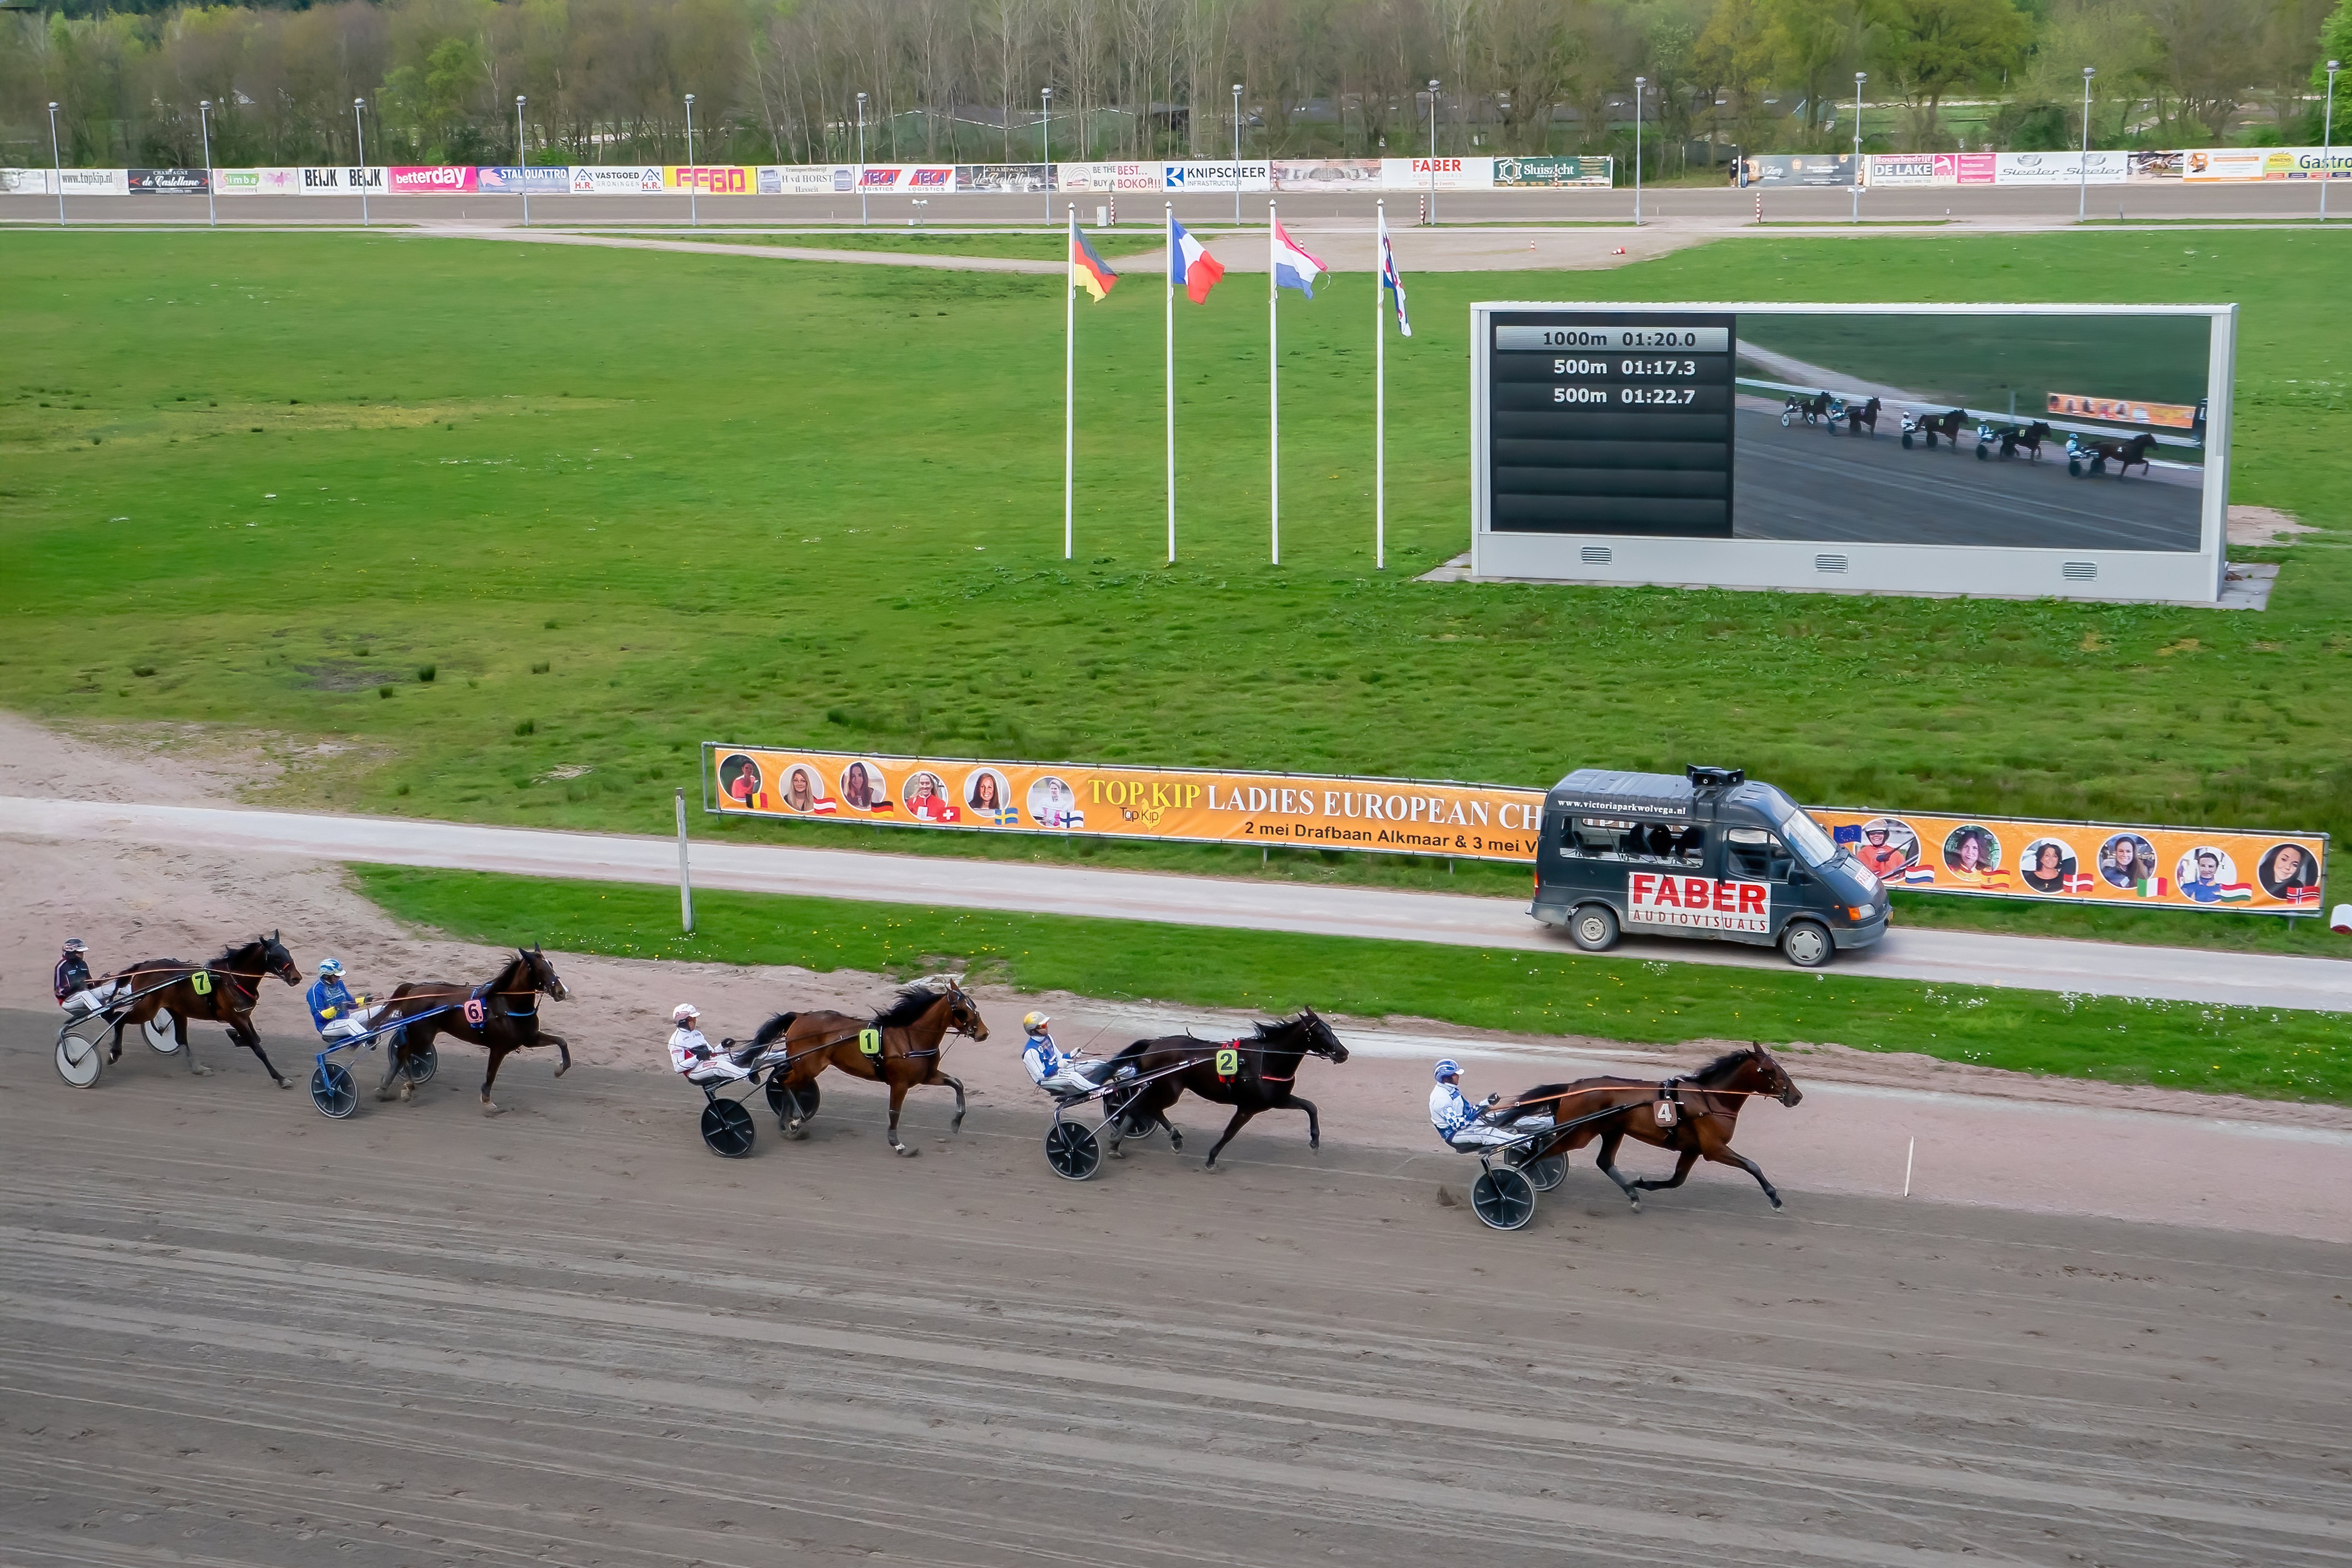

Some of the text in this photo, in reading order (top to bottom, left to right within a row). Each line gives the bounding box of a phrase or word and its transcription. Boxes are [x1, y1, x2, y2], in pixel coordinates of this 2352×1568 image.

[501, 169, 567, 179] STAL QUATTRO
[1118, 165, 1147, 175] BEST...
[1187, 167, 1266, 178] KNIPSCHEER
[1412, 160, 1462, 172] FABER
[1523, 163, 1575, 175] Sluiszcht
[1875, 165, 1931, 176] DE LAKE
[396, 167, 467, 189] betterday
[864, 172, 895, 185] TECA
[915, 172, 946, 185] TECA
[1544, 332, 1696, 346] 1000m 01:20.0
[1554, 359, 1695, 376] 500m 01:17.3
[1554, 388, 1695, 404] 500m 01:22.7
[1087, 779, 1145, 806] TOP
[1152, 782, 1201, 809] KIP
[1208, 785, 1314, 815] LADIES
[1323, 791, 1490, 827] EUROPEAN
[1558, 800, 1686, 815] www.victoriaparkwolvega.nl
[1119, 807, 1159, 824] Top Kip
[1245, 822, 1254, 834] 2
[1259, 824, 1289, 836] mei
[1295, 824, 1372, 841] Drafbaan
[1377, 829, 1450, 847] Alkmaar
[1455, 835, 1467, 848] &
[1473, 837, 1483, 849] 3
[1488, 839, 1519, 852] mei
[1633, 874, 1766, 915] FABER
[1633, 910, 1766, 931] AUDIOVISUALS
[195, 975, 204, 990] 7
[468, 1004, 479, 1020] 6
[865, 1033, 872, 1049] 1
[1220, 1053, 1233, 1071] 2
[1658, 1103, 1672, 1122] 4
